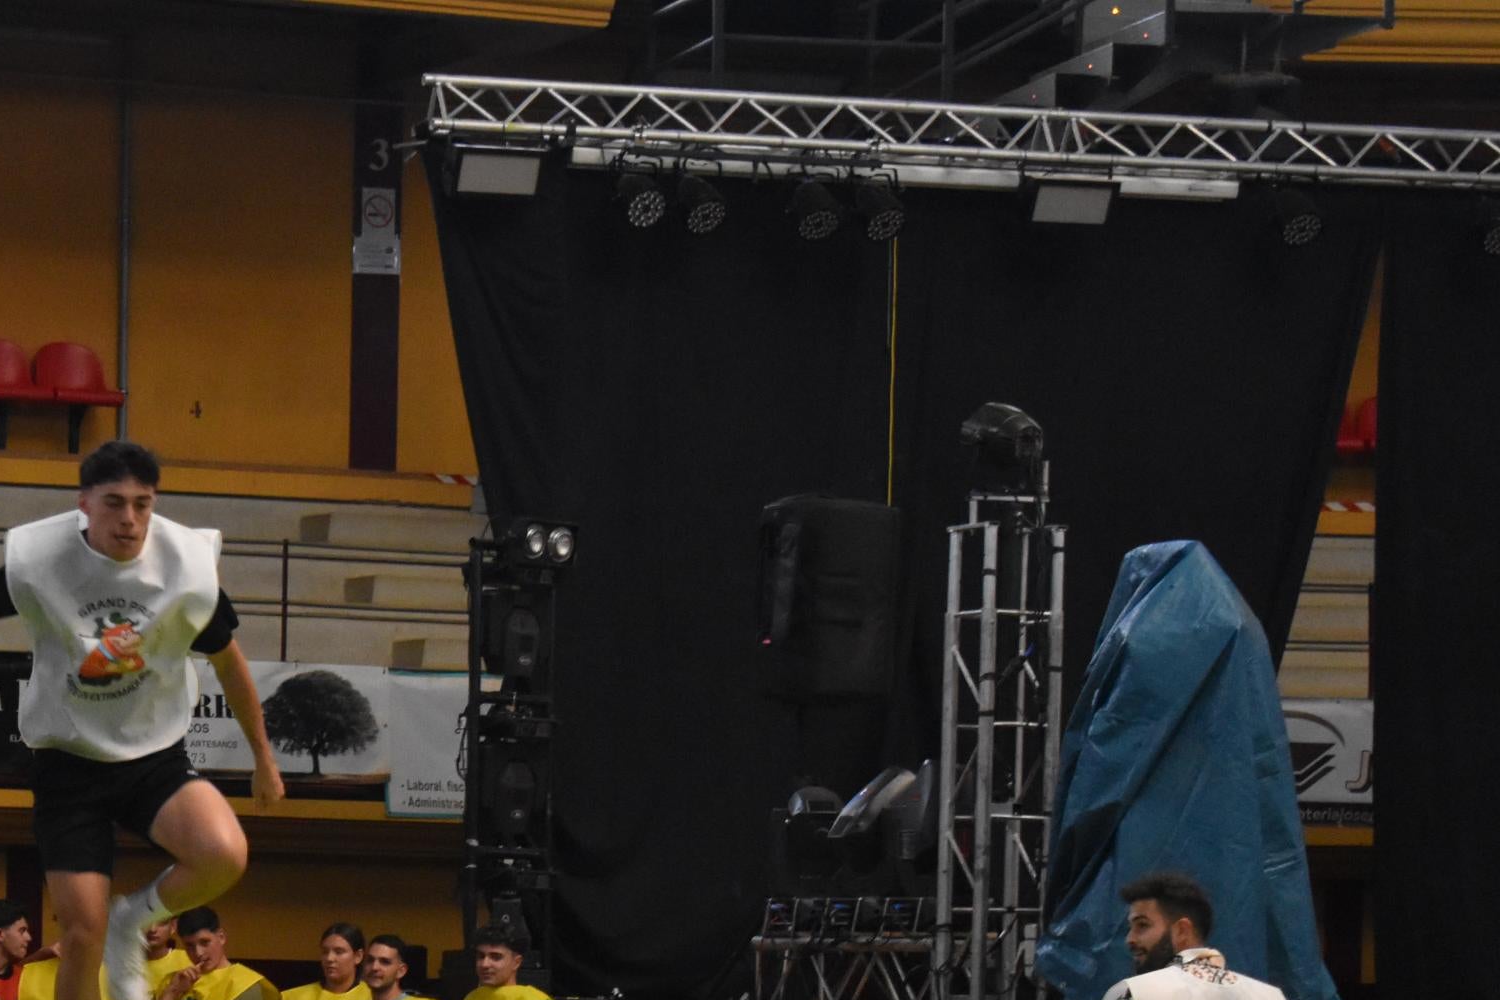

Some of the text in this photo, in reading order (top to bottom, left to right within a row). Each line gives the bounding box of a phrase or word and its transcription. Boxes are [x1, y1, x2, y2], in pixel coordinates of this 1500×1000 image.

[369, 139, 389, 172] 3
[406, 778, 466, 792] Laboral, fisc
[407, 796, 465, 809] Administrac
